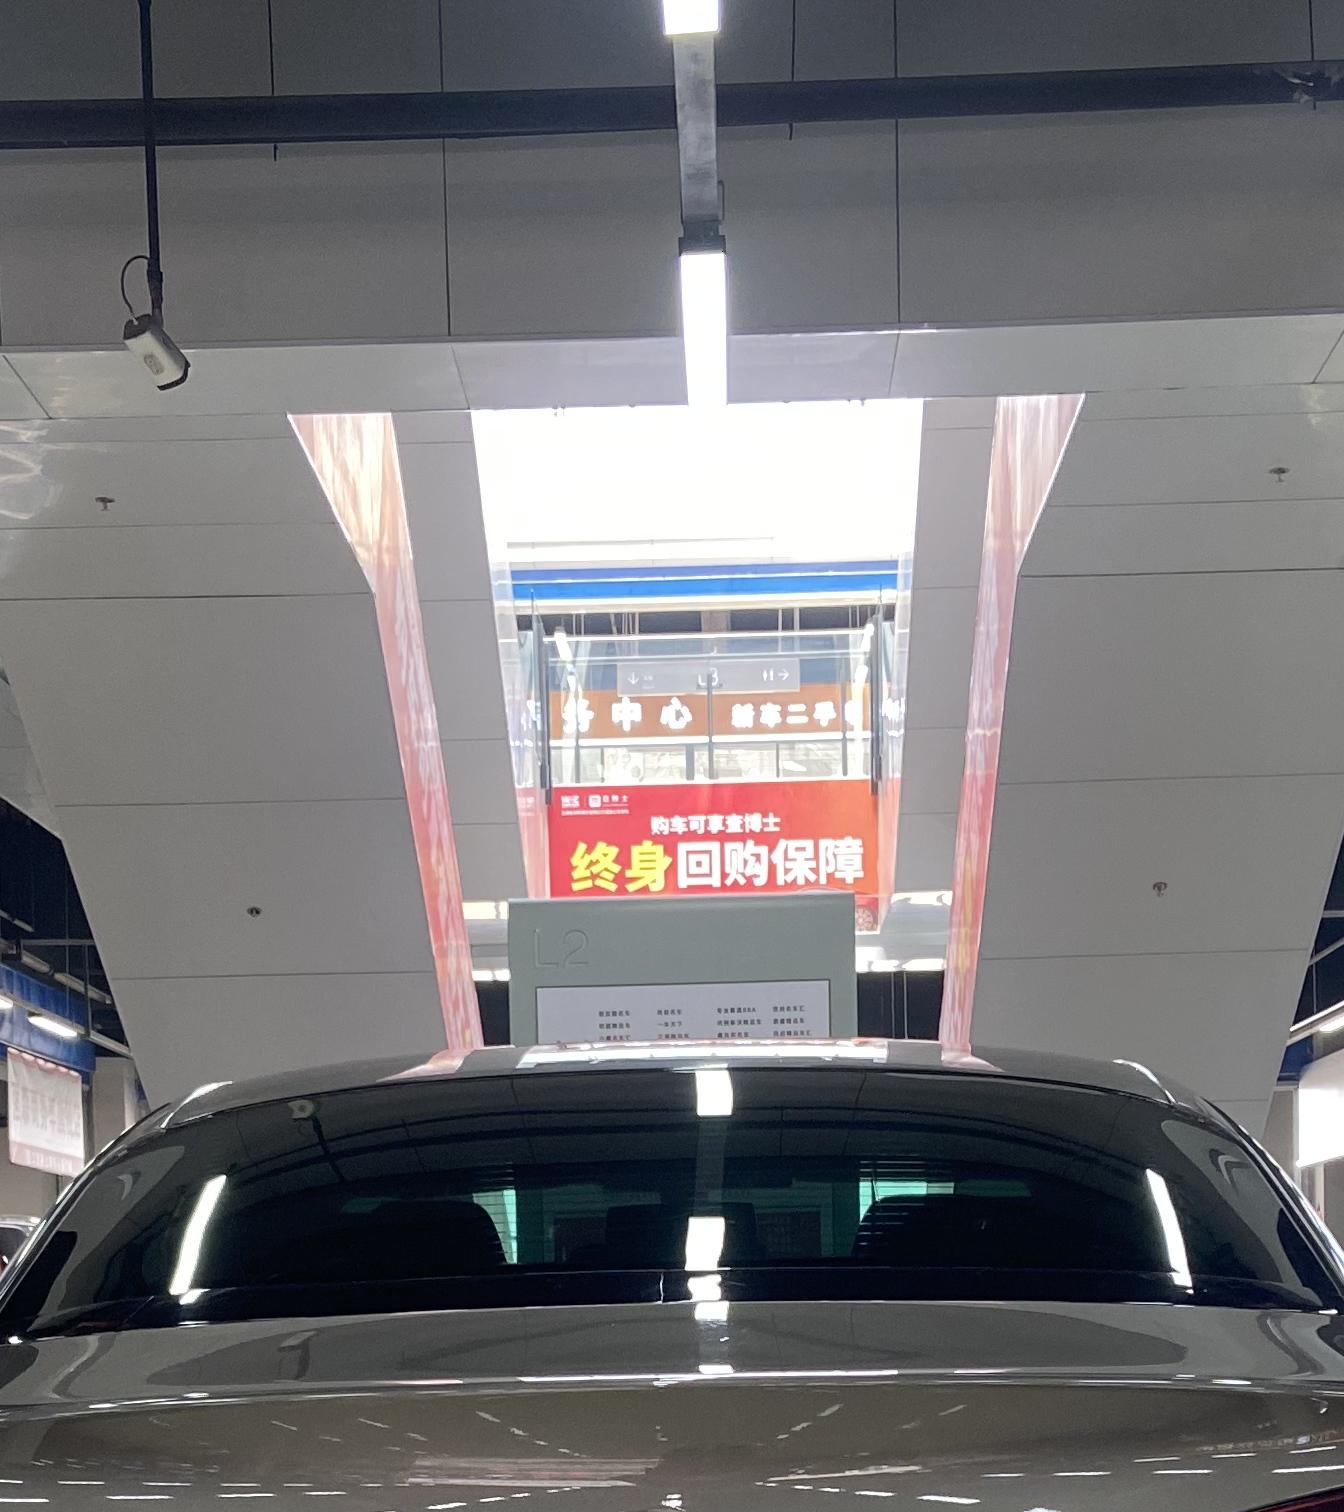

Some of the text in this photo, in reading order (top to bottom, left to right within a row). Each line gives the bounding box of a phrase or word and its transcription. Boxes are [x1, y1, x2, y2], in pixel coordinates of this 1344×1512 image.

[651, 813, 781, 836] 购车可享查博士
[570, 837, 865, 894] 终身回购保障
[532, 927, 591, 969] L2
